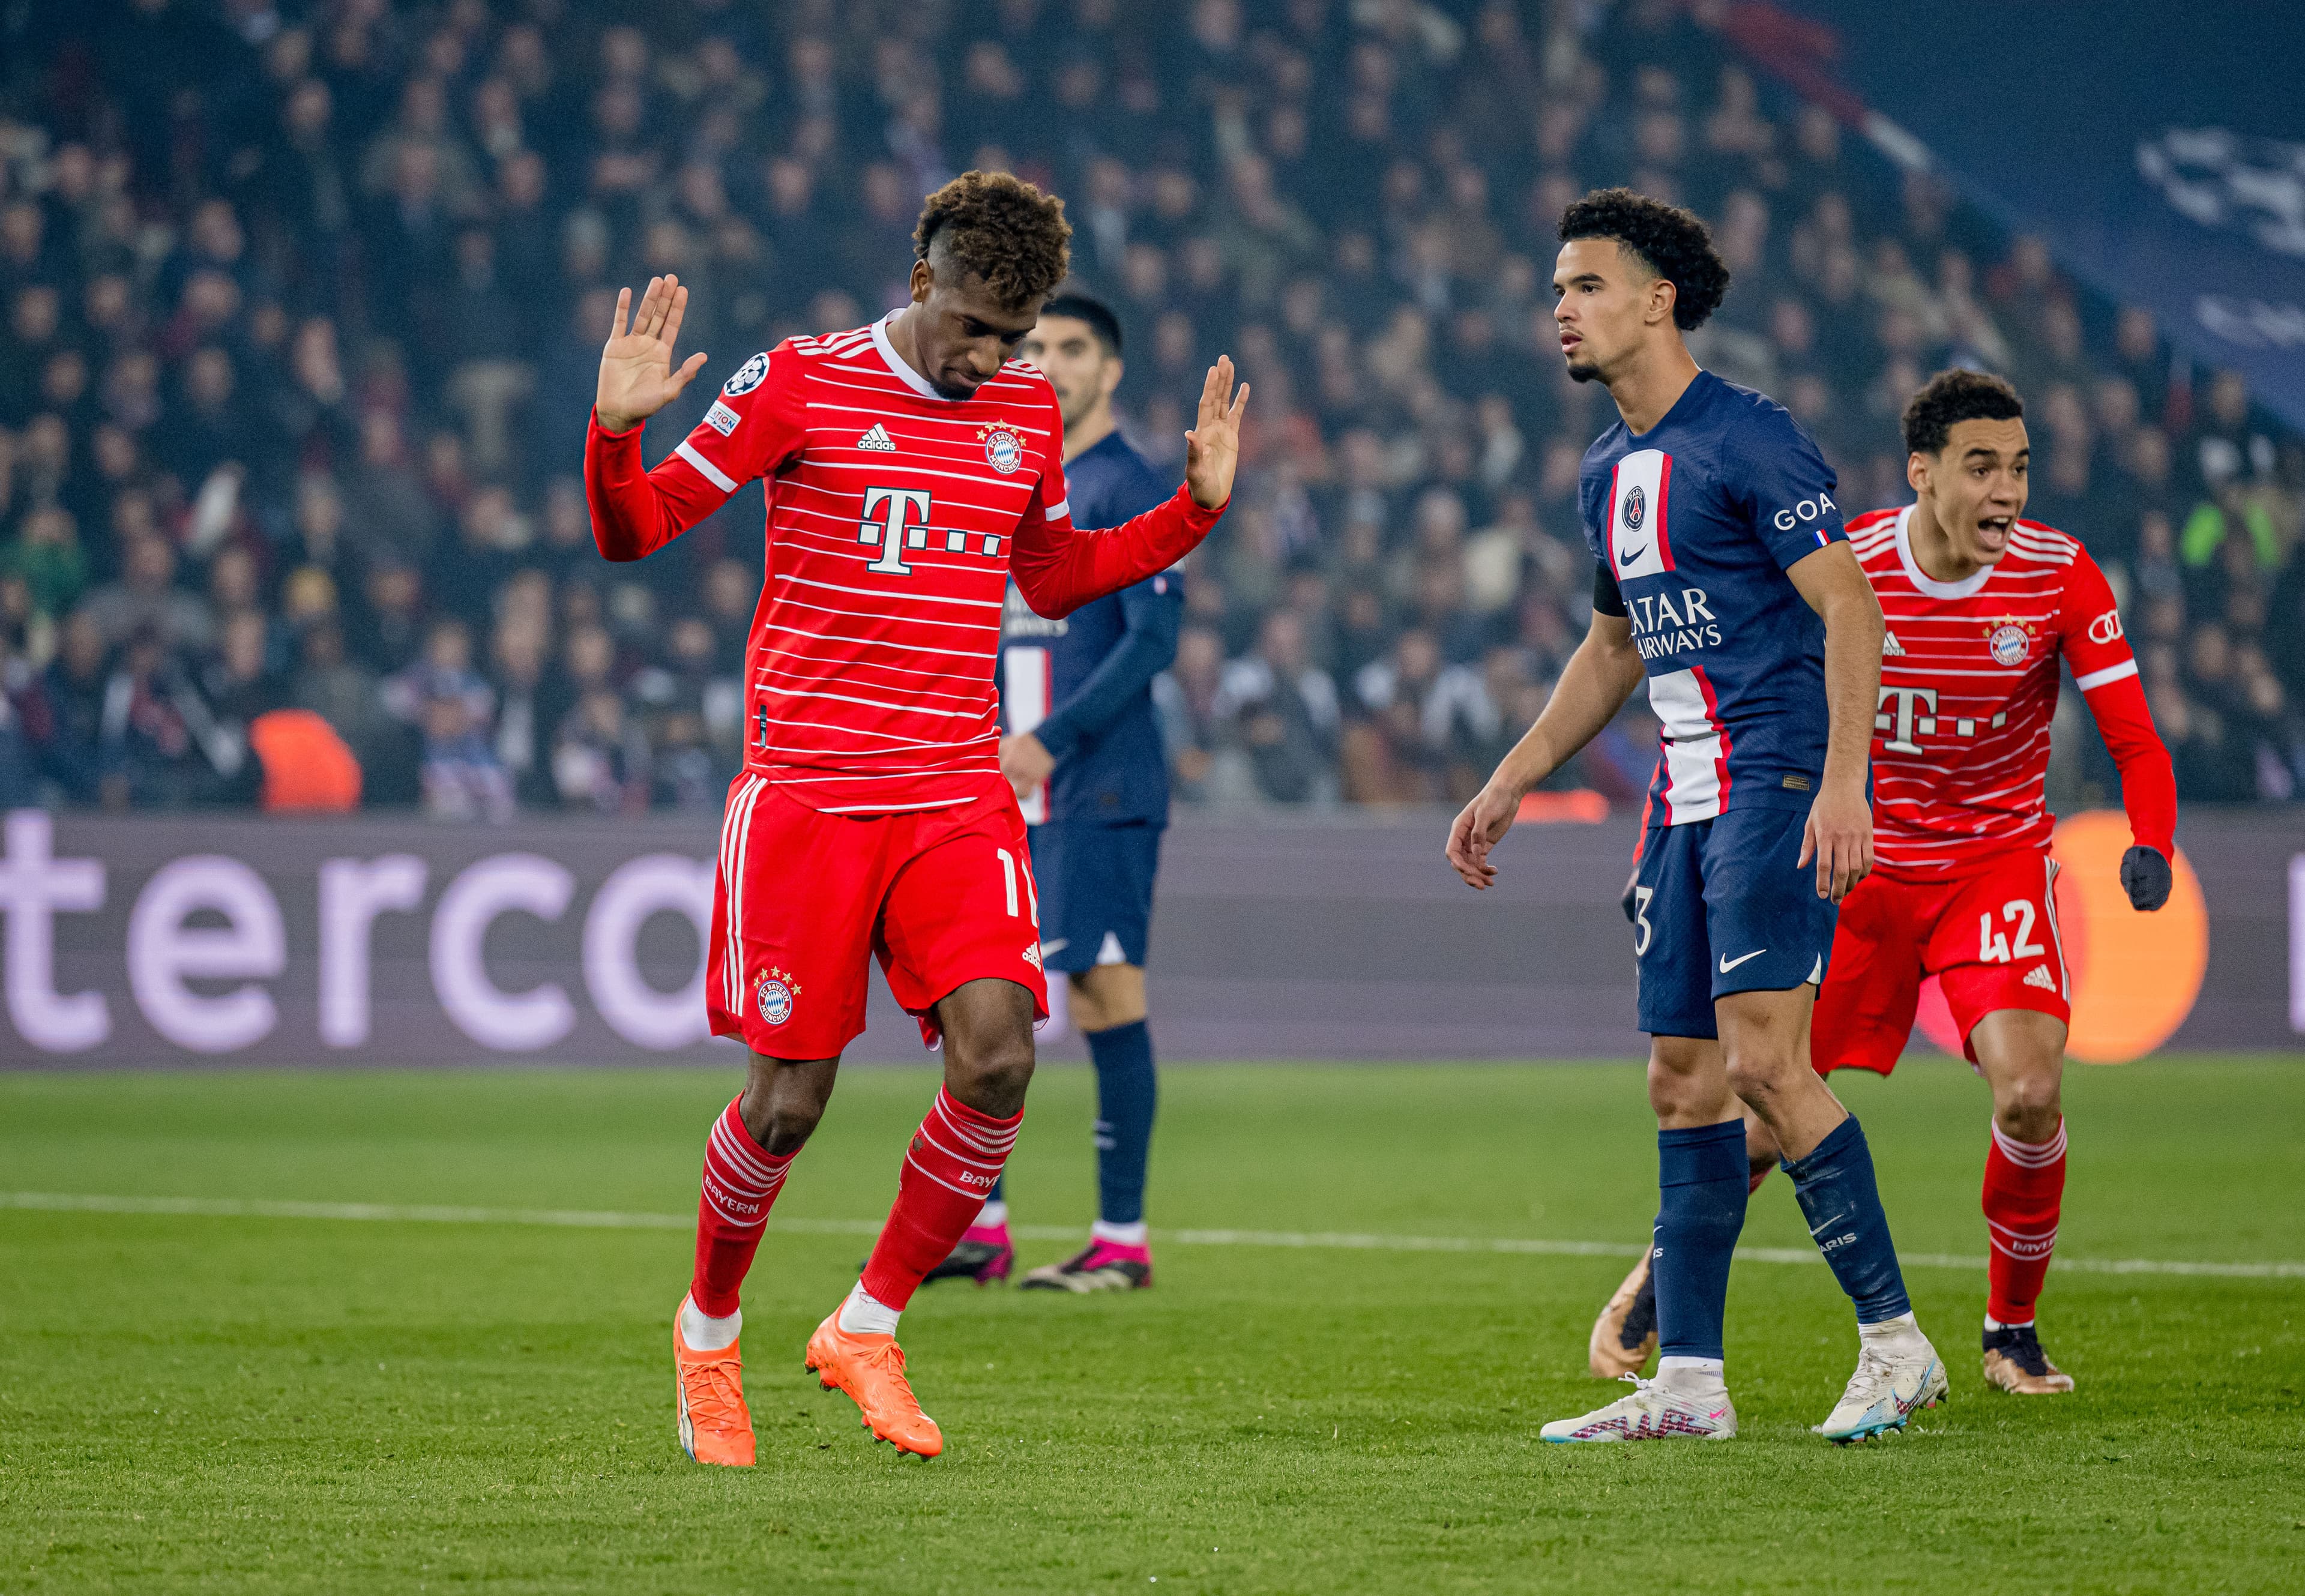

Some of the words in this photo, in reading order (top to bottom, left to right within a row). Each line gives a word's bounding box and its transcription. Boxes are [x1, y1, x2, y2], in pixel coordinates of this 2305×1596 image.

[857, 439, 896, 451] adidas
[989, 438, 996, 448] FC
[996, 434, 1019, 452] BAYERN
[1629, 489, 1643, 501] PARIS
[1774, 492, 1836, 531] GOA
[1624, 588, 1717, 637] ATAR
[1638, 624, 1722, 660] AIRWAYS
[1979, 899, 2046, 964] 42
[761, 988, 768, 998] FC
[767, 984, 790, 1002] BAYERN
[705, 1174, 760, 1214] BAYERN
